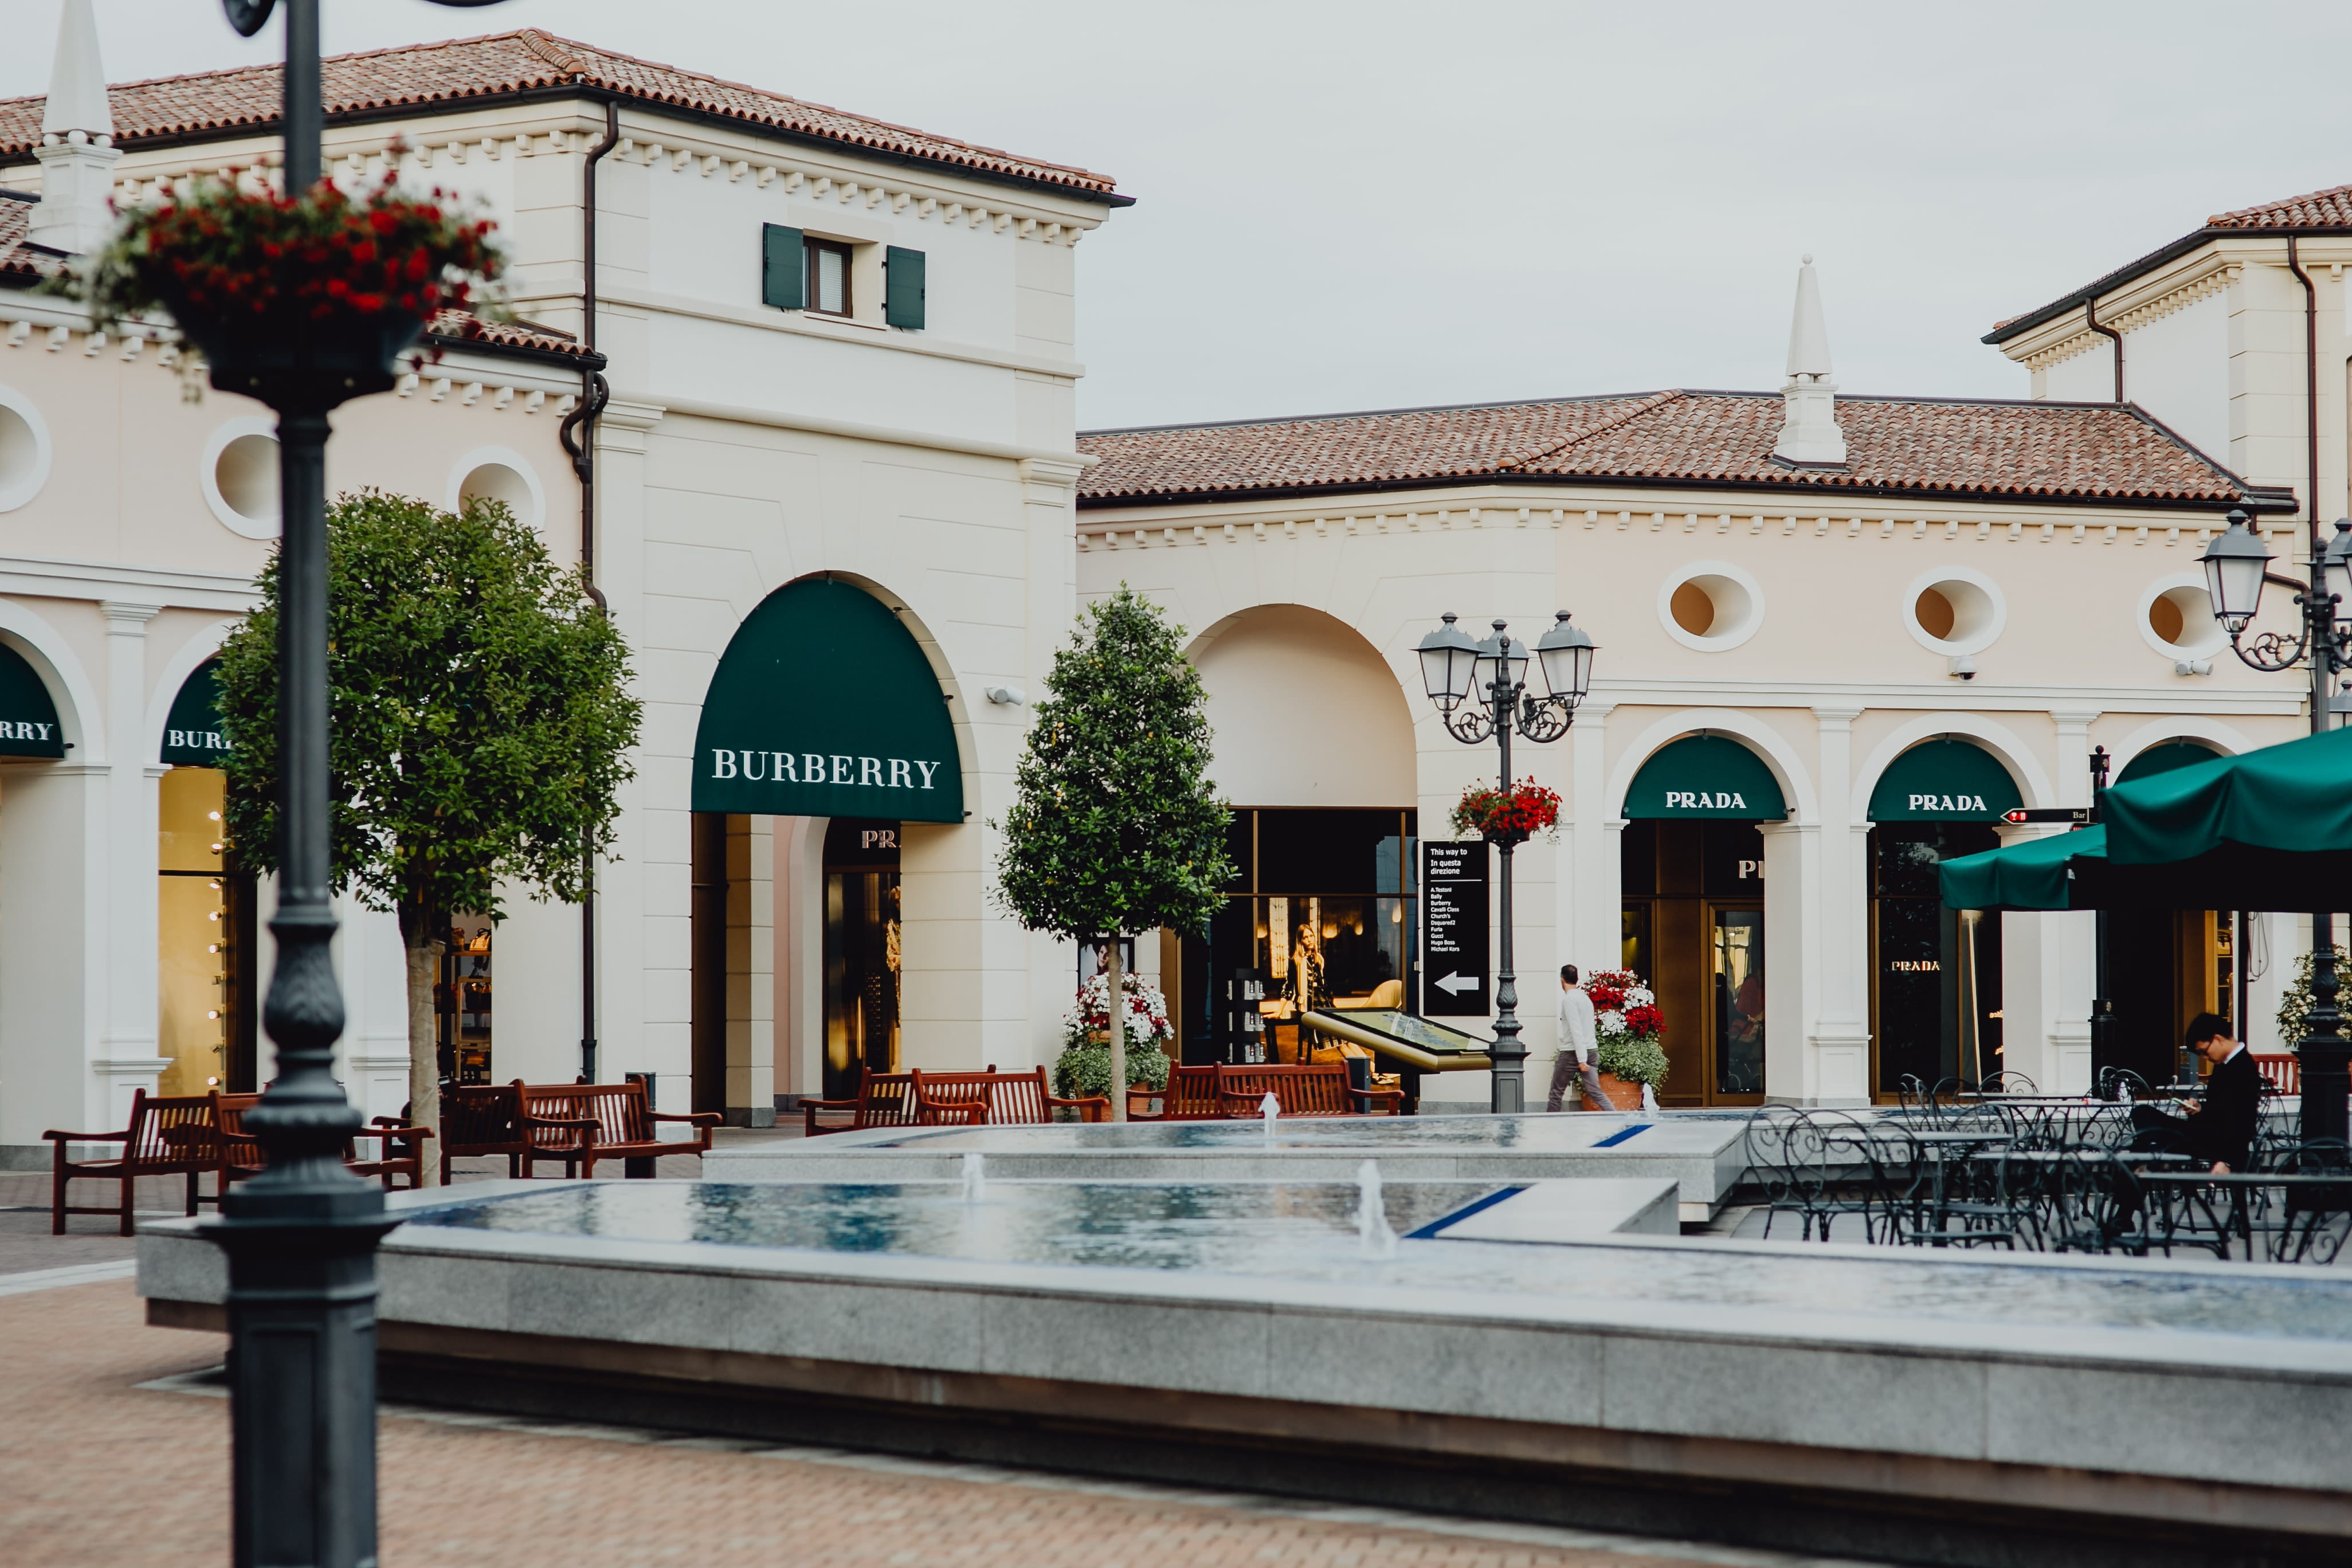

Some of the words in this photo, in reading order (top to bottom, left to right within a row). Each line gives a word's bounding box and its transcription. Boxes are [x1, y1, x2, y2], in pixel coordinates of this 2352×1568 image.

[711, 748, 941, 789] BURBERRY
[1666, 791, 1747, 809] PRADA
[1908, 794, 1987, 811] PRADA
[861, 830, 901, 848] PR
[1439, 860, 1461, 868] questa
[1892, 961, 1941, 971] PRADA
